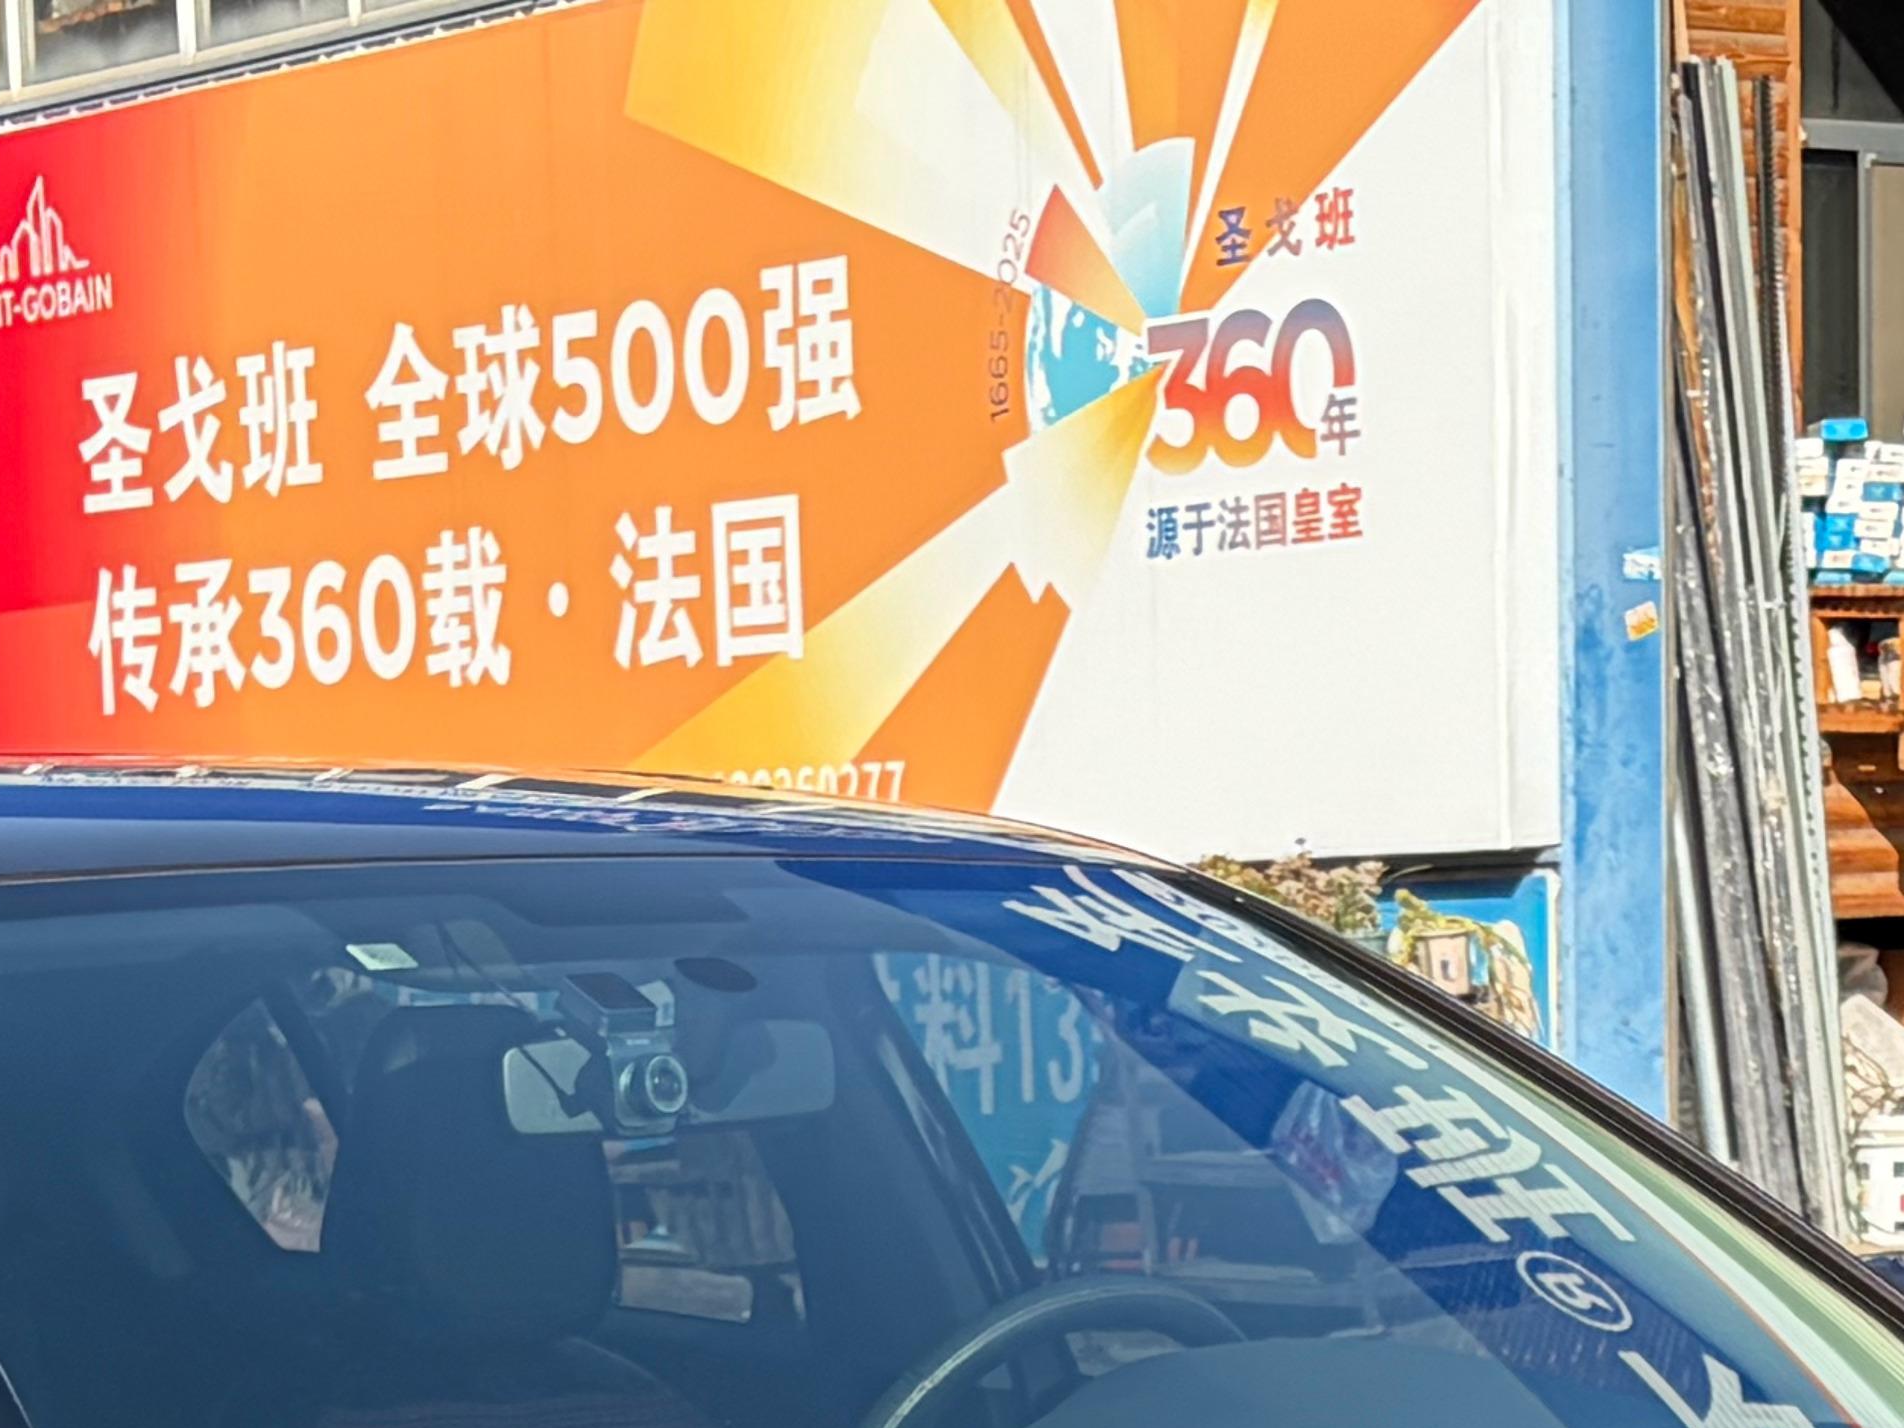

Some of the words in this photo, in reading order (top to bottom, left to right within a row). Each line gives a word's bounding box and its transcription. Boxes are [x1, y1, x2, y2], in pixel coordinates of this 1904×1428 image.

[1215, 186, 1356, 267] 圣戈班
[79, 340, 324, 516] 圣戈班
[365, 254, 863, 483] 全球500强
[987, 208, 1032, 423] 1665-2025
[1144, 482, 1364, 562] 源于法国皇室
